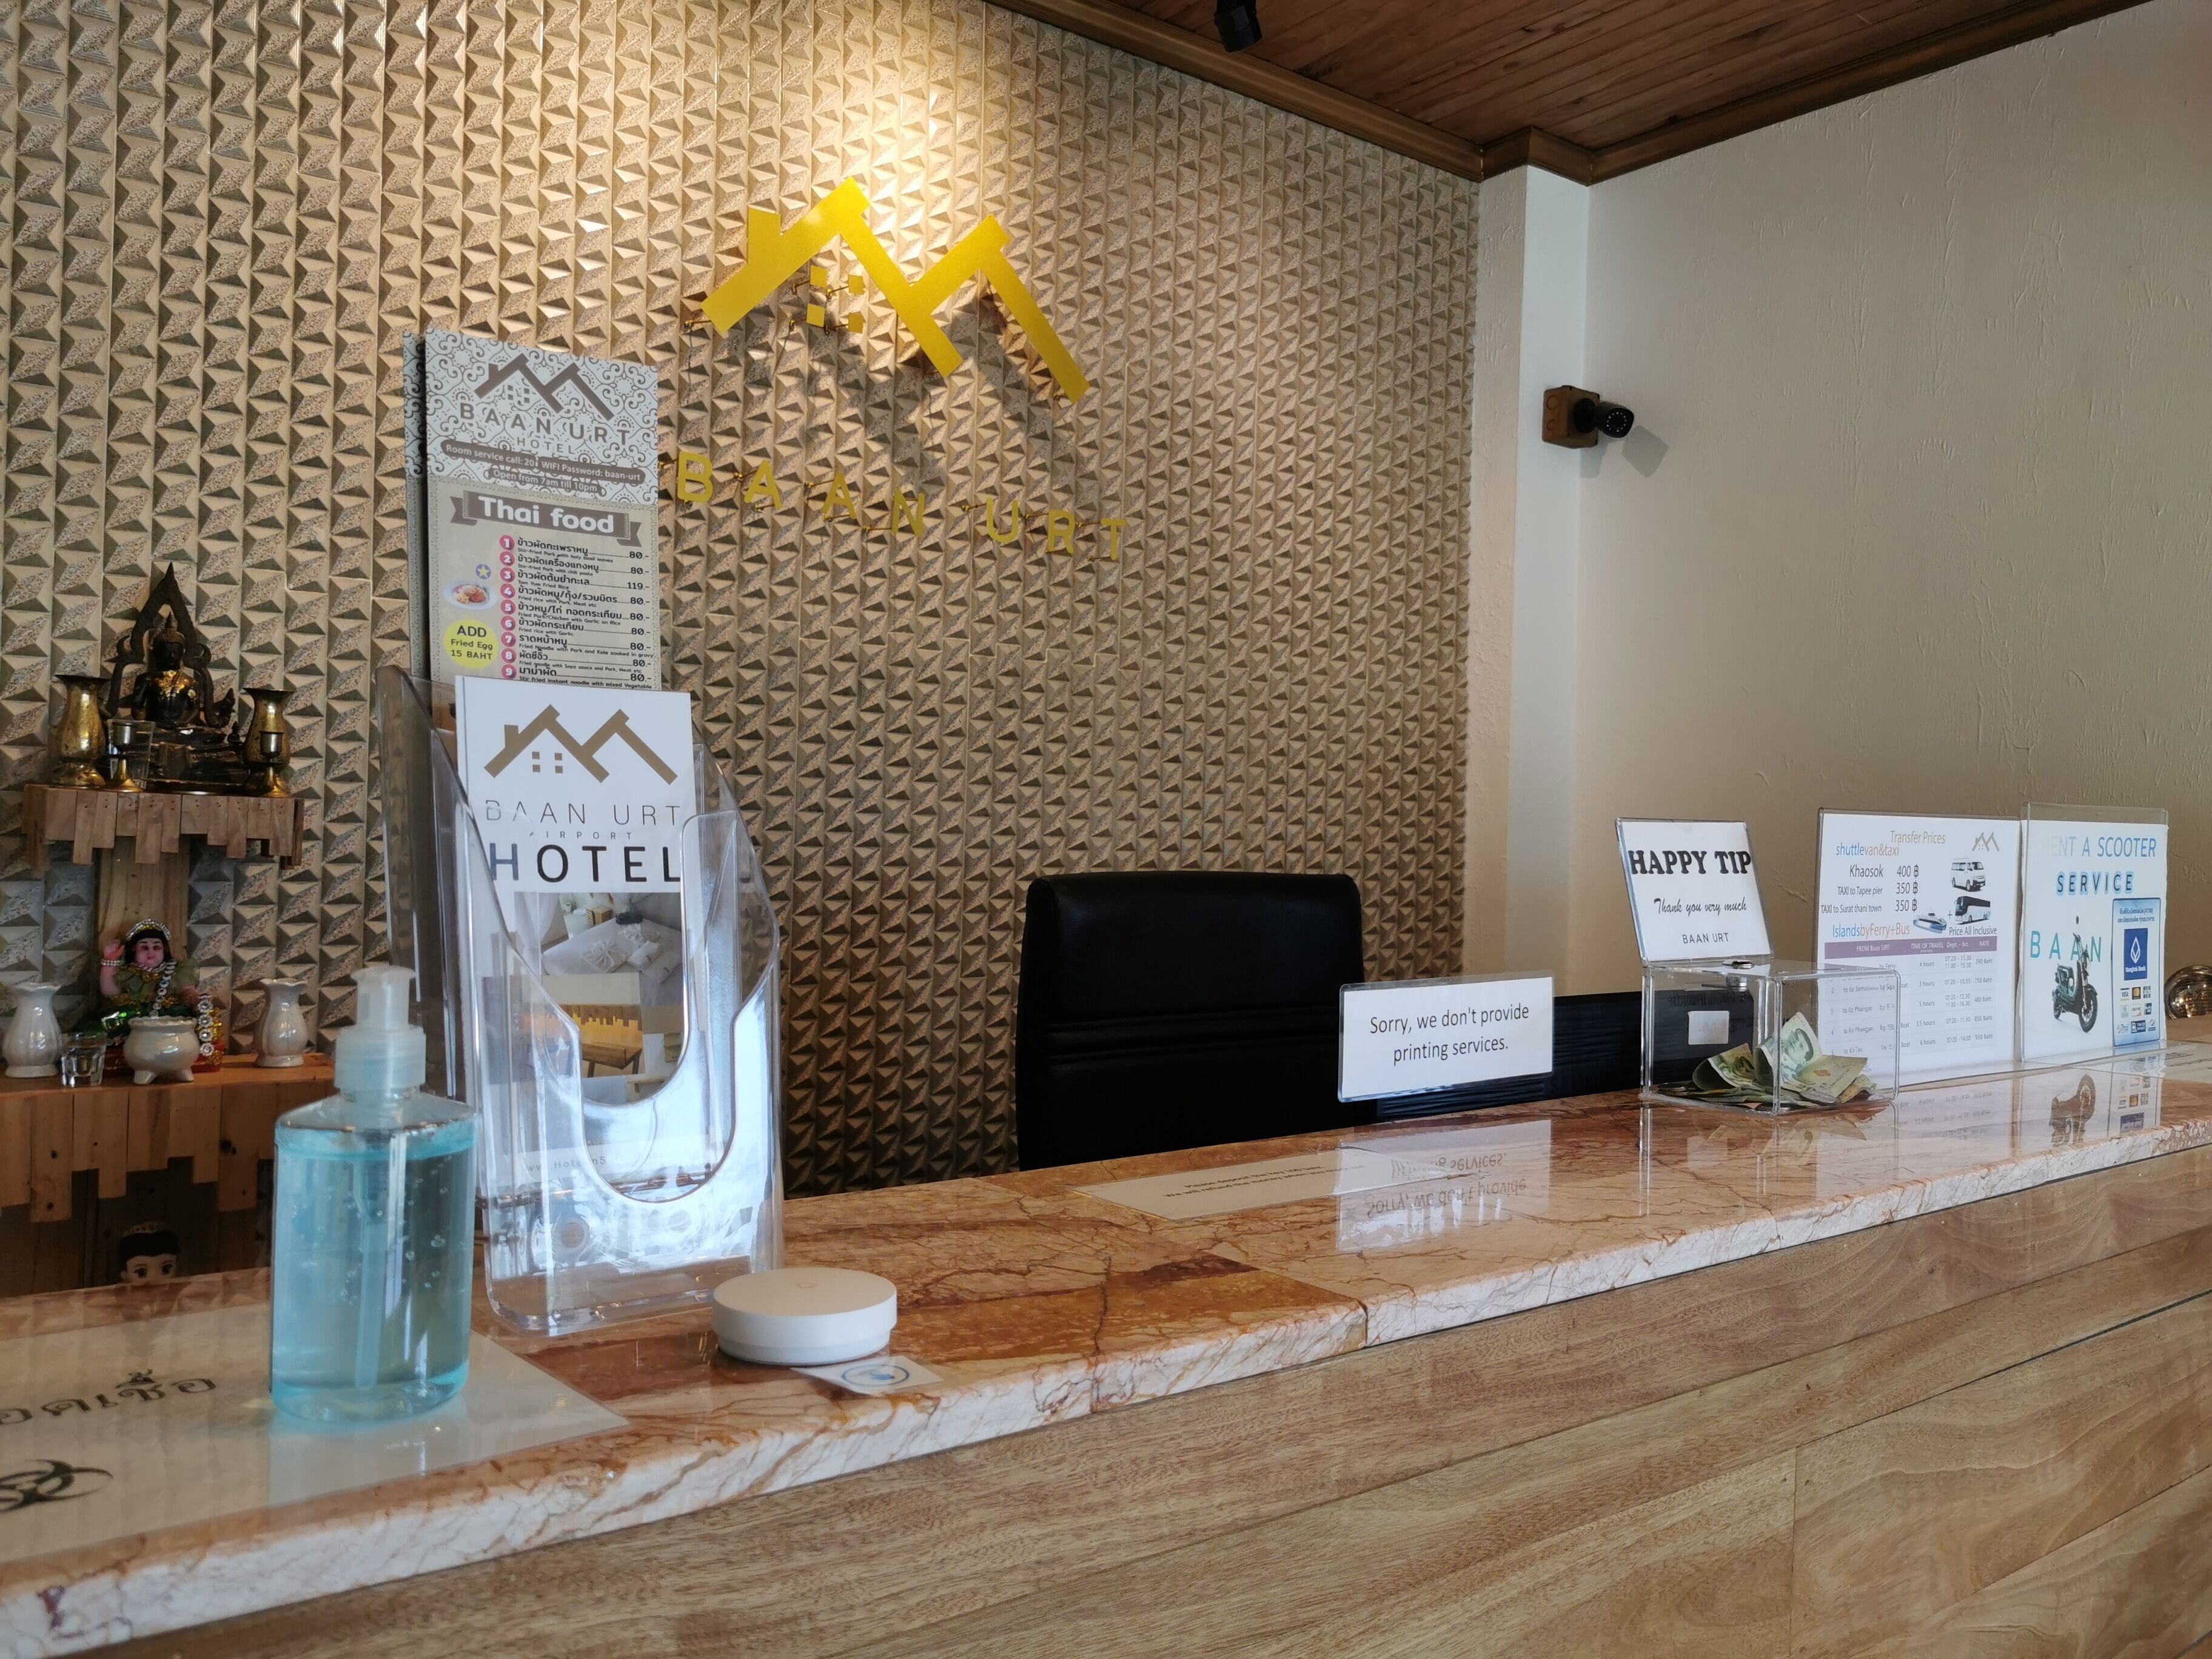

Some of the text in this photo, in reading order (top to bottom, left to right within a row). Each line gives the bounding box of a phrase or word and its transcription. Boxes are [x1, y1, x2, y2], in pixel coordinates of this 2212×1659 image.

[460, 403, 630, 446] BAAN URT
[517, 437, 575, 454] HOTEL
[446, 444, 534, 467] Room service call: 20
[541, 461, 641, 481] WIFI Password: baan-urt
[493, 470, 597, 492] Open from 7am till 10pm
[677, 451, 1127, 560] BAAN URT
[478, 495, 614, 534] Thai food
[504, 538, 510, 548] 1
[504, 555, 511, 563] 2
[504, 587, 512, 595] 4
[504, 603, 511, 612] 5
[457, 625, 487, 637] ADD
[504, 619, 512, 628] 6
[451, 638, 493, 651] Fried Egg
[505, 635, 512, 643] 7
[467, 651, 492, 660] BAHT
[505, 668, 512, 676] 9
[614, 805, 680, 826] URT
[1890, 830, 1946, 844] Transfer Prices
[1835, 842, 1900, 857] shuttlevan&taxi
[2082, 837, 2090, 857] A
[2097, 837, 2156, 857] SCOOTER
[489, 843, 680, 883] HOTEL
[1628, 850, 1751, 874] HAPPY TIP
[1849, 863, 1883, 877] Khaosok
[1896, 865, 1911, 877] 400
[1837, 886, 1849, 895] TAXI
[1856, 886, 1871, 897] Tapee
[1872, 886, 1883, 897] pier
[1895, 882, 1910, 894] 350
[2057, 874, 2133, 893] SERVICE
[1654, 896, 1747, 916] Thank you very much
[1821, 905, 1832, 914] TAXI
[1840, 904, 1853, 913] Surat
[1854, 903, 1868, 913] thani
[1895, 899, 1909, 911] 350
[1682, 933, 1729, 943] BAAN URT
[1832, 922, 1910, 939] IslandsbyFerry+Bus
[1949, 927, 1963, 936] Price
[1972, 925, 1997, 935] Inclusive
[1370, 1002, 1529, 1035] Sorry, we don't provide
[1393, 1036, 1509, 1066] printing services.
